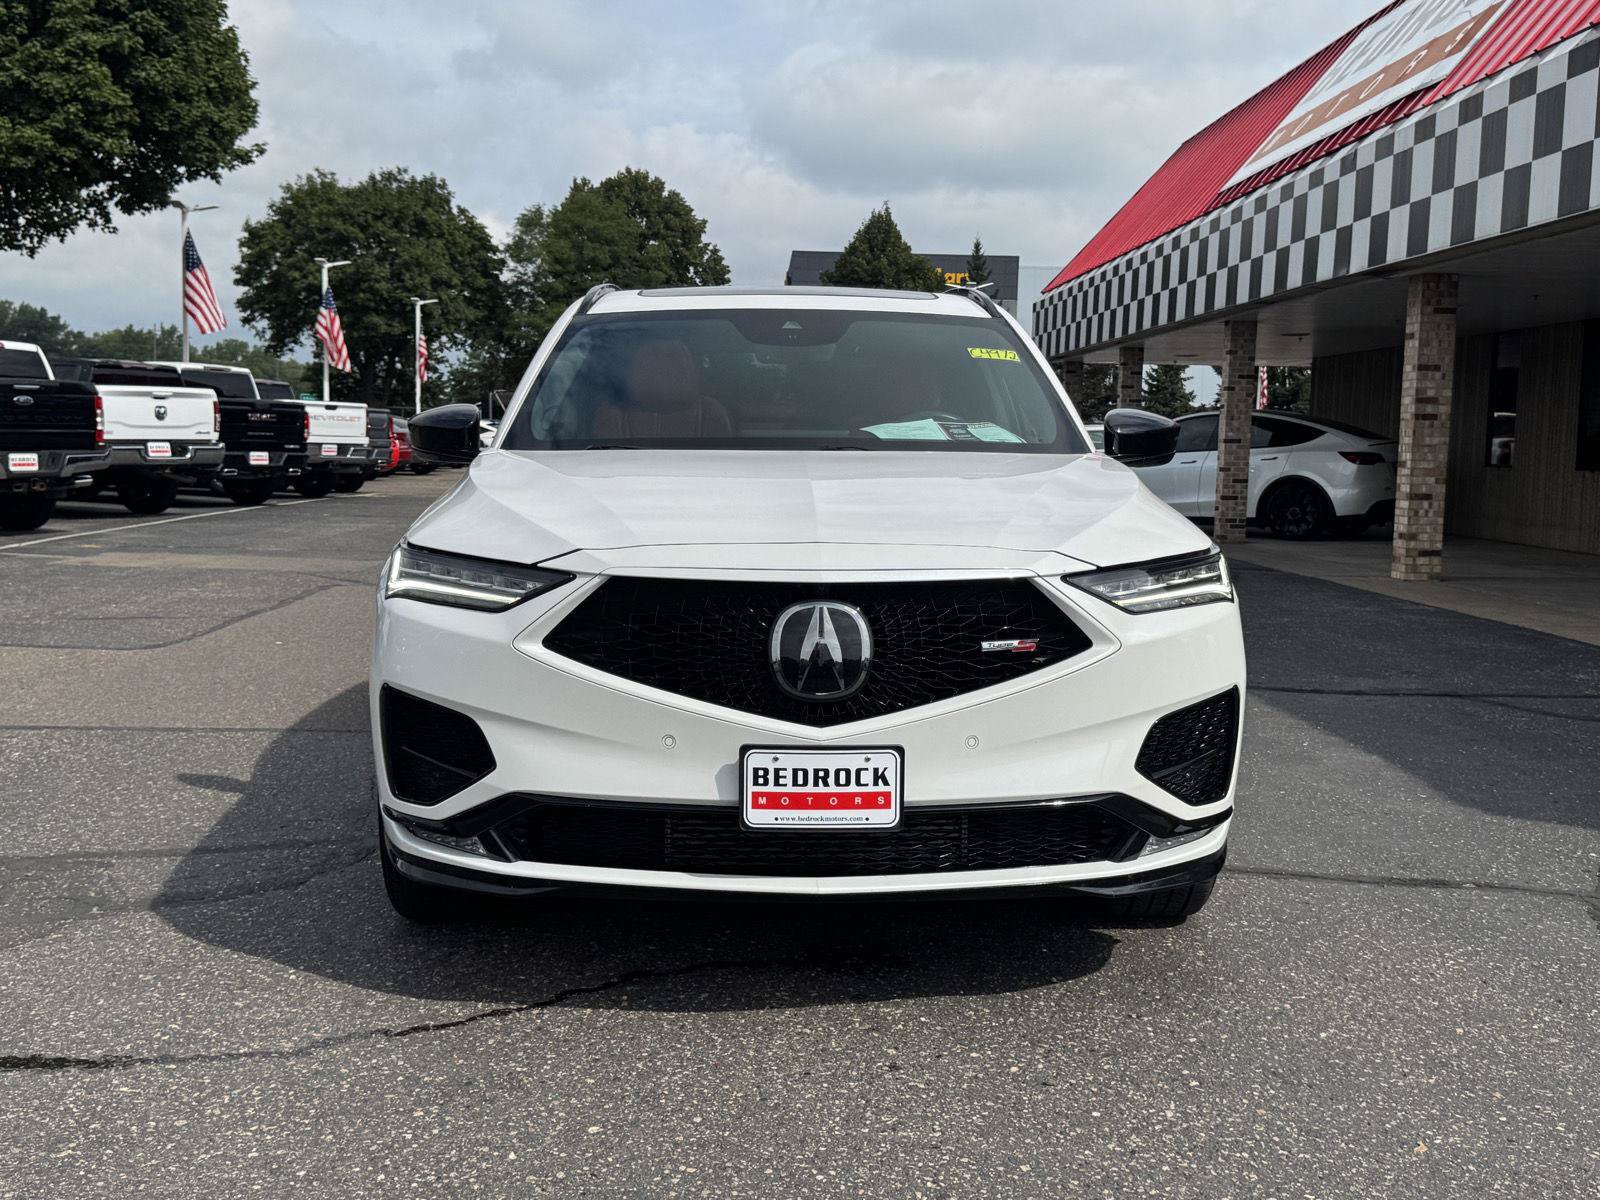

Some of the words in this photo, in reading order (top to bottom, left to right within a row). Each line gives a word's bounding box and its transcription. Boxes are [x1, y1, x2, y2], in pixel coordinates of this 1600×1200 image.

[1263, 21, 1475, 153] MOTORS
[752, 767, 890, 787] BEDROCK
[758, 796, 885, 805] MOTORS
